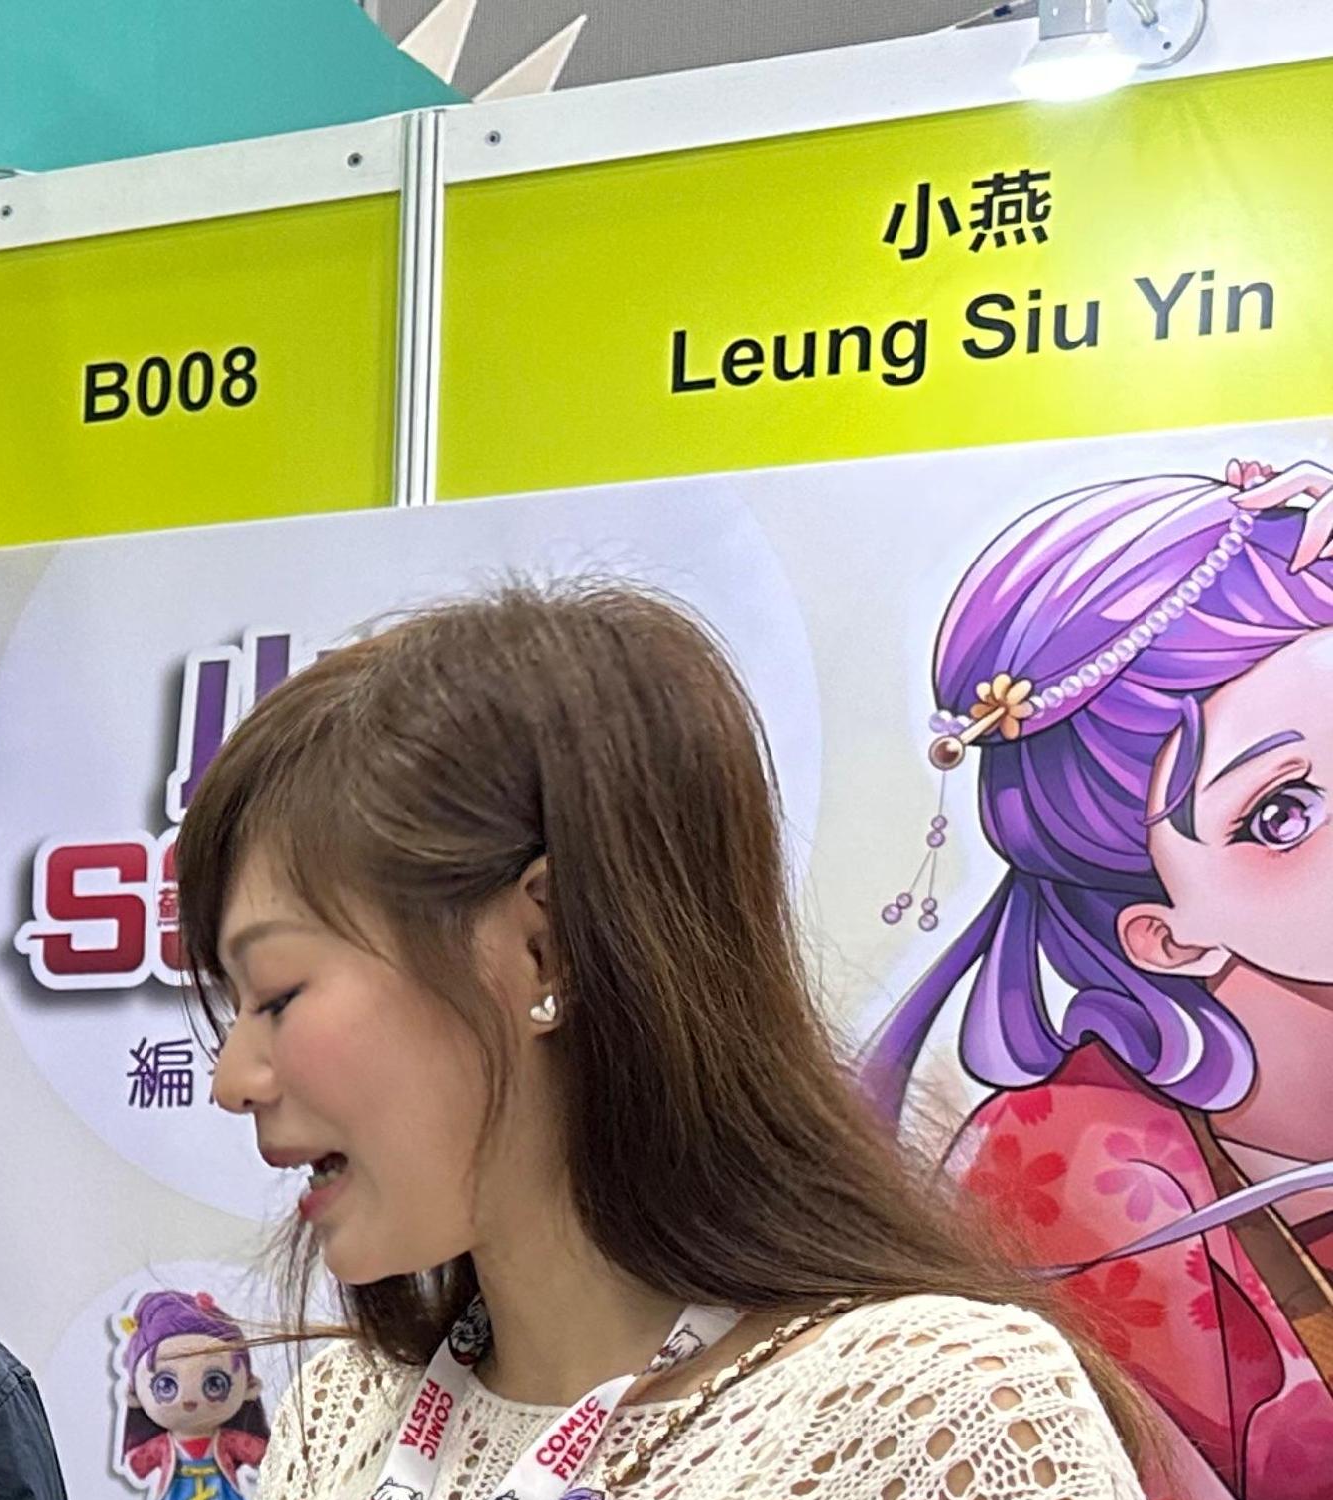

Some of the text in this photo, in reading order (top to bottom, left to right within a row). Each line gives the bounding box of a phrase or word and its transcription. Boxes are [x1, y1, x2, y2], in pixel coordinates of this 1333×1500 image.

[882, 169, 1052, 261] 小燕
[670, 266, 1276, 394] Leung Siu Yin
[83, 345, 259, 424] B008
[27, 842, 201, 976] S
[127, 1037, 221, 1109] 編
[399, 1378, 441, 1448] FIESTA
[420, 1391, 453, 1461] COMIC
[535, 1395, 600, 1466] COMIC
[552, 1408, 608, 1481] FIESTA
